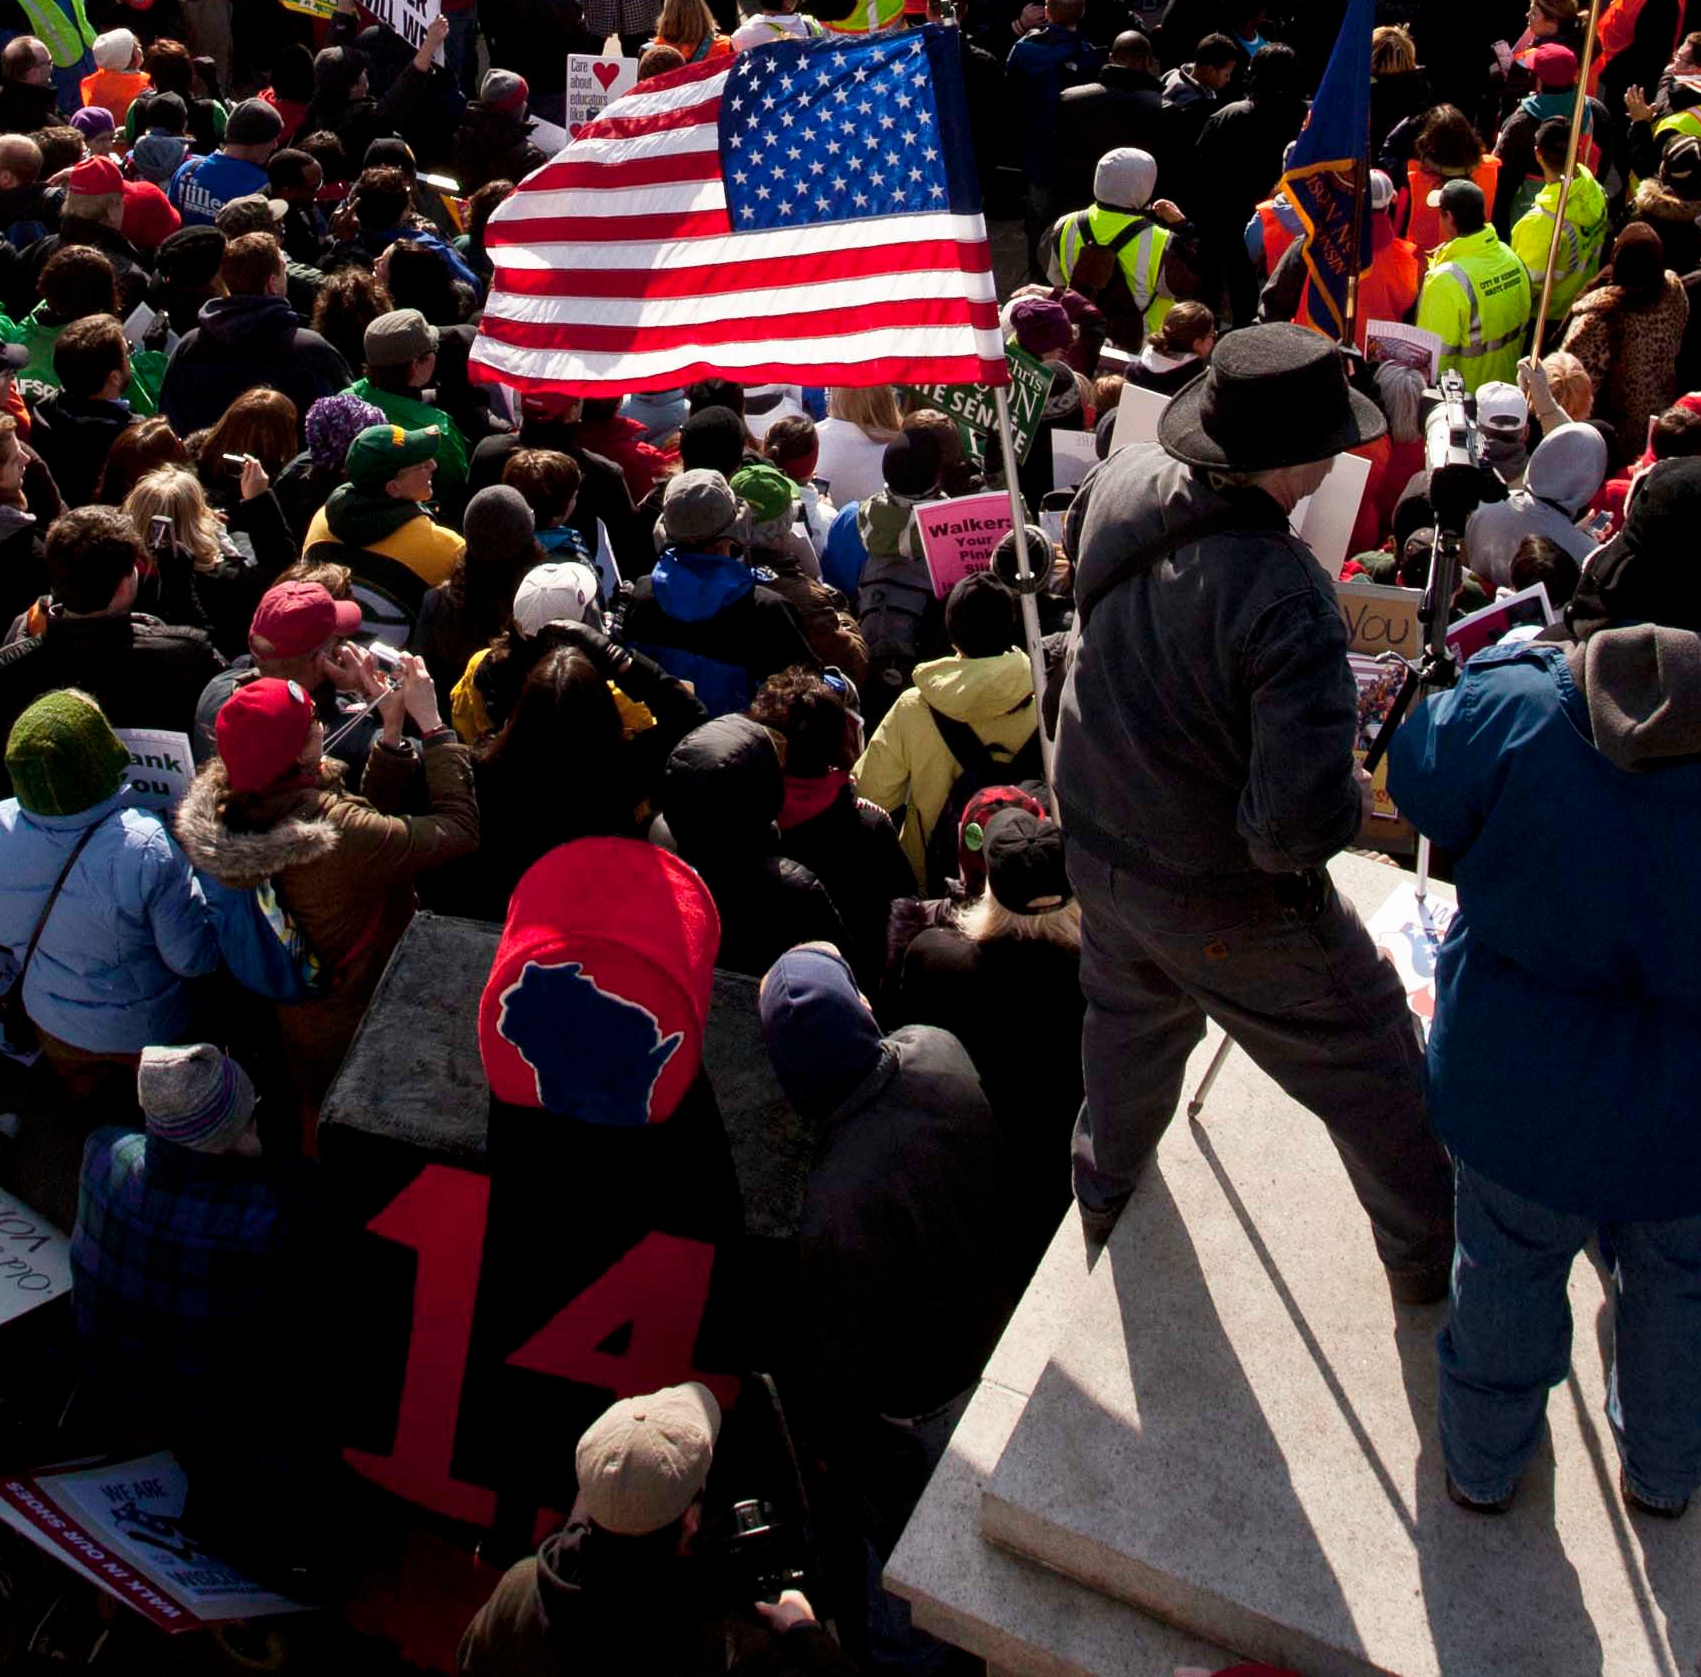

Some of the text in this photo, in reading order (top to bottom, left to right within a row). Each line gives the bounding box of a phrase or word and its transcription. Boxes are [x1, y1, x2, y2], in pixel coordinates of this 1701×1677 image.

[570, 58, 588, 73] Care
[570, 76, 593, 90] about
[570, 93, 608, 106] educators
[569, 108, 584, 122] like
[928, 517, 1011, 539] Walker:
[956, 535, 993, 548] Your
[1344, 604, 1409, 644] YOU
[338, 1164, 742, 1548] 14
[102, 1478, 166, 1503] WE ARE
[5, 1480, 66, 1530] SHOES
[64, 1529, 106, 1560] OUR
[103, 1560, 130, 1578] IN
[129, 1579, 183, 1618] WALK
